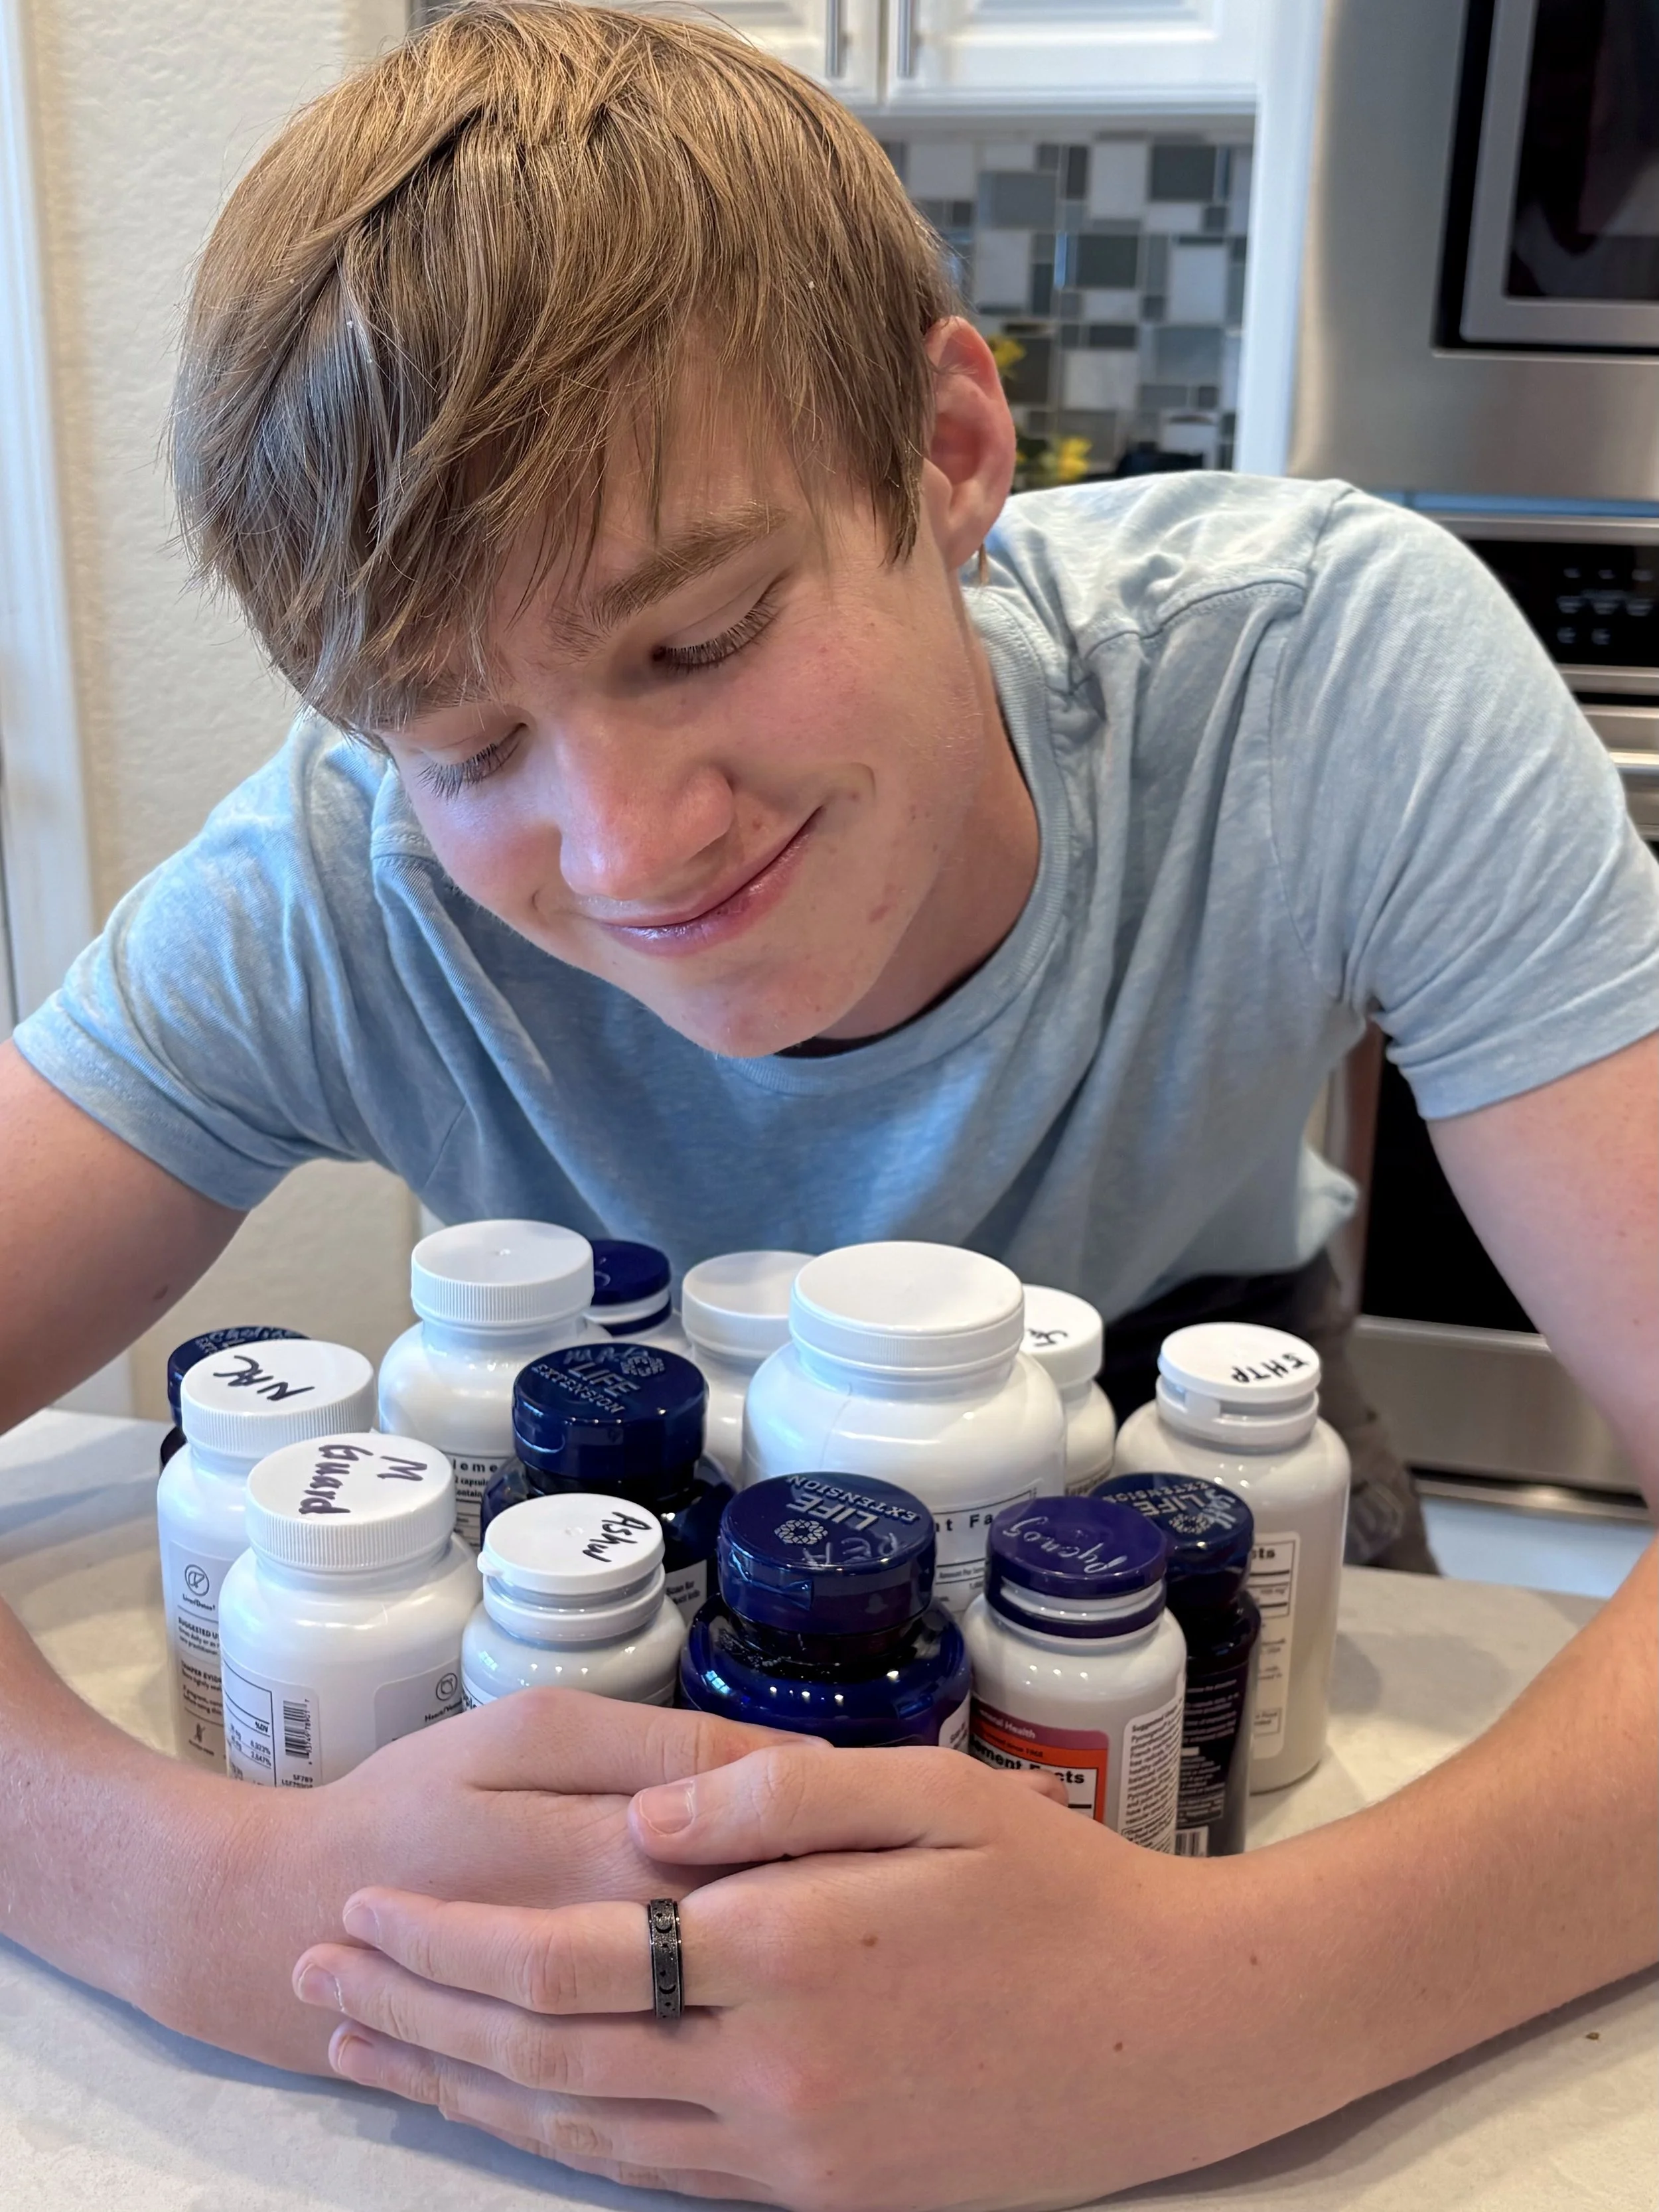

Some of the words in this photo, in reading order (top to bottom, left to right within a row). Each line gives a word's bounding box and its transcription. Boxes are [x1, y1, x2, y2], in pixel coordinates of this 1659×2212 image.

[212, 1355, 315, 1402] NAC
[532, 1363, 626, 1414] EXTENSION
[568, 1362, 641, 1398] LIFE
[298, 1444, 374, 1514] Guard
[376, 1455, 428, 1481] M
[786, 1474, 922, 1524] EXTENSION
[1102, 1481, 1209, 1503] EXTENSION
[1133, 1494, 1205, 1516] LIFE
[786, 1493, 879, 1531] LIFE
[582, 1511, 653, 1563] Ashw
[254, 1721, 269, 1733] %DV
[1004, 1720, 1036, 1739] Health
